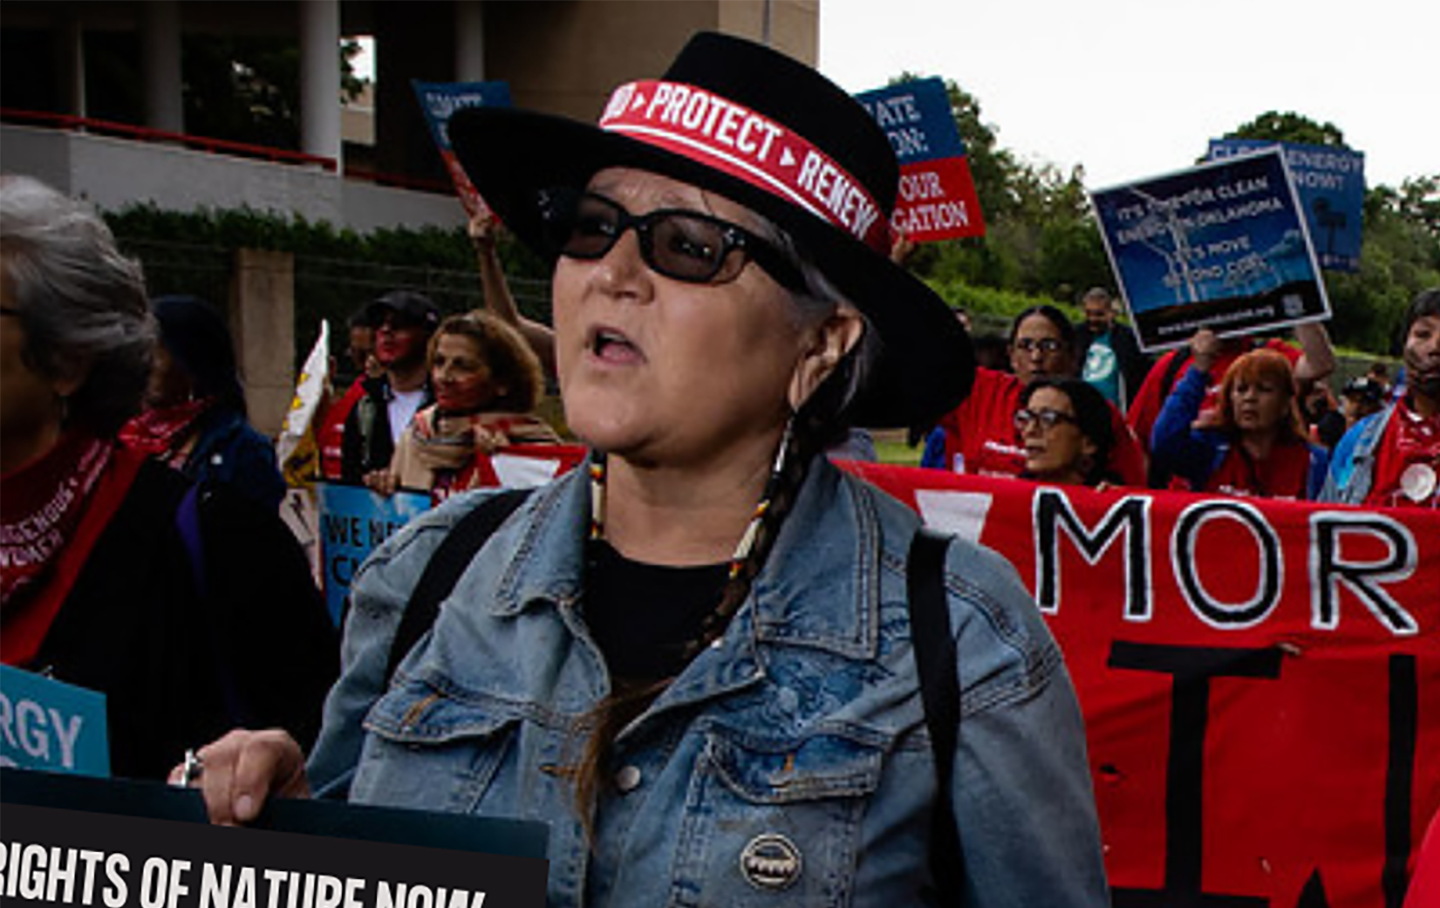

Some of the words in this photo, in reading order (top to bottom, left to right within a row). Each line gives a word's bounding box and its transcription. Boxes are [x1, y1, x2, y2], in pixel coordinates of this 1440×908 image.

[863, 95, 921, 127] ATE
[645, 82, 784, 161] PROTECT
[797, 150, 879, 241] RENEW
[899, 171, 945, 201] OUR
[1218, 175, 1269, 199] CLEAN
[1199, 197, 1284, 228] OKLAHOMA
[1208, 236, 1250, 255] MOVE
[326, 513, 363, 548] WE
[140, 856, 191, 908] OF
[199, 861, 366, 908] NATURE
